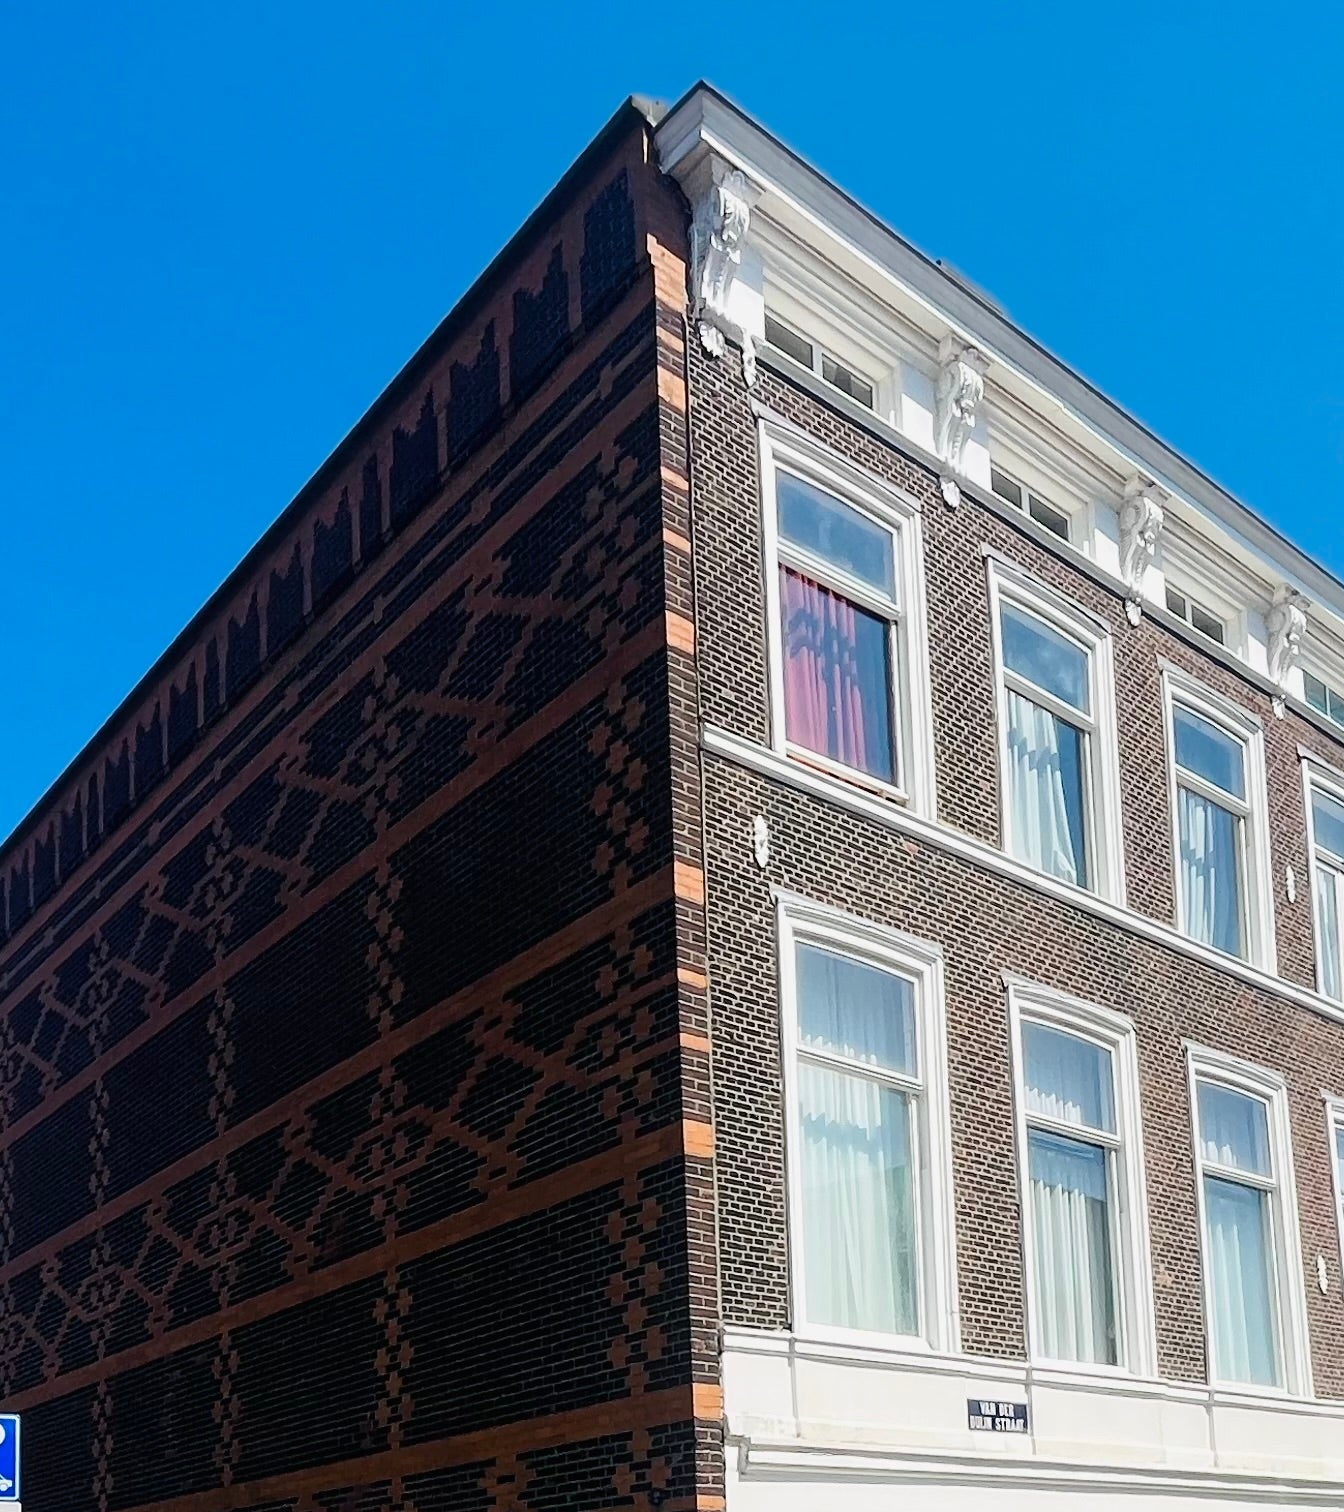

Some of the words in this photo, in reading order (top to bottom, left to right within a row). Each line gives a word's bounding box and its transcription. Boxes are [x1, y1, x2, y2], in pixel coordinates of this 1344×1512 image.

[979, 1401, 996, 1415] VAN
[999, 1403, 1014, 1417] DER
[995, 1417, 1024, 1431] STRAAT
